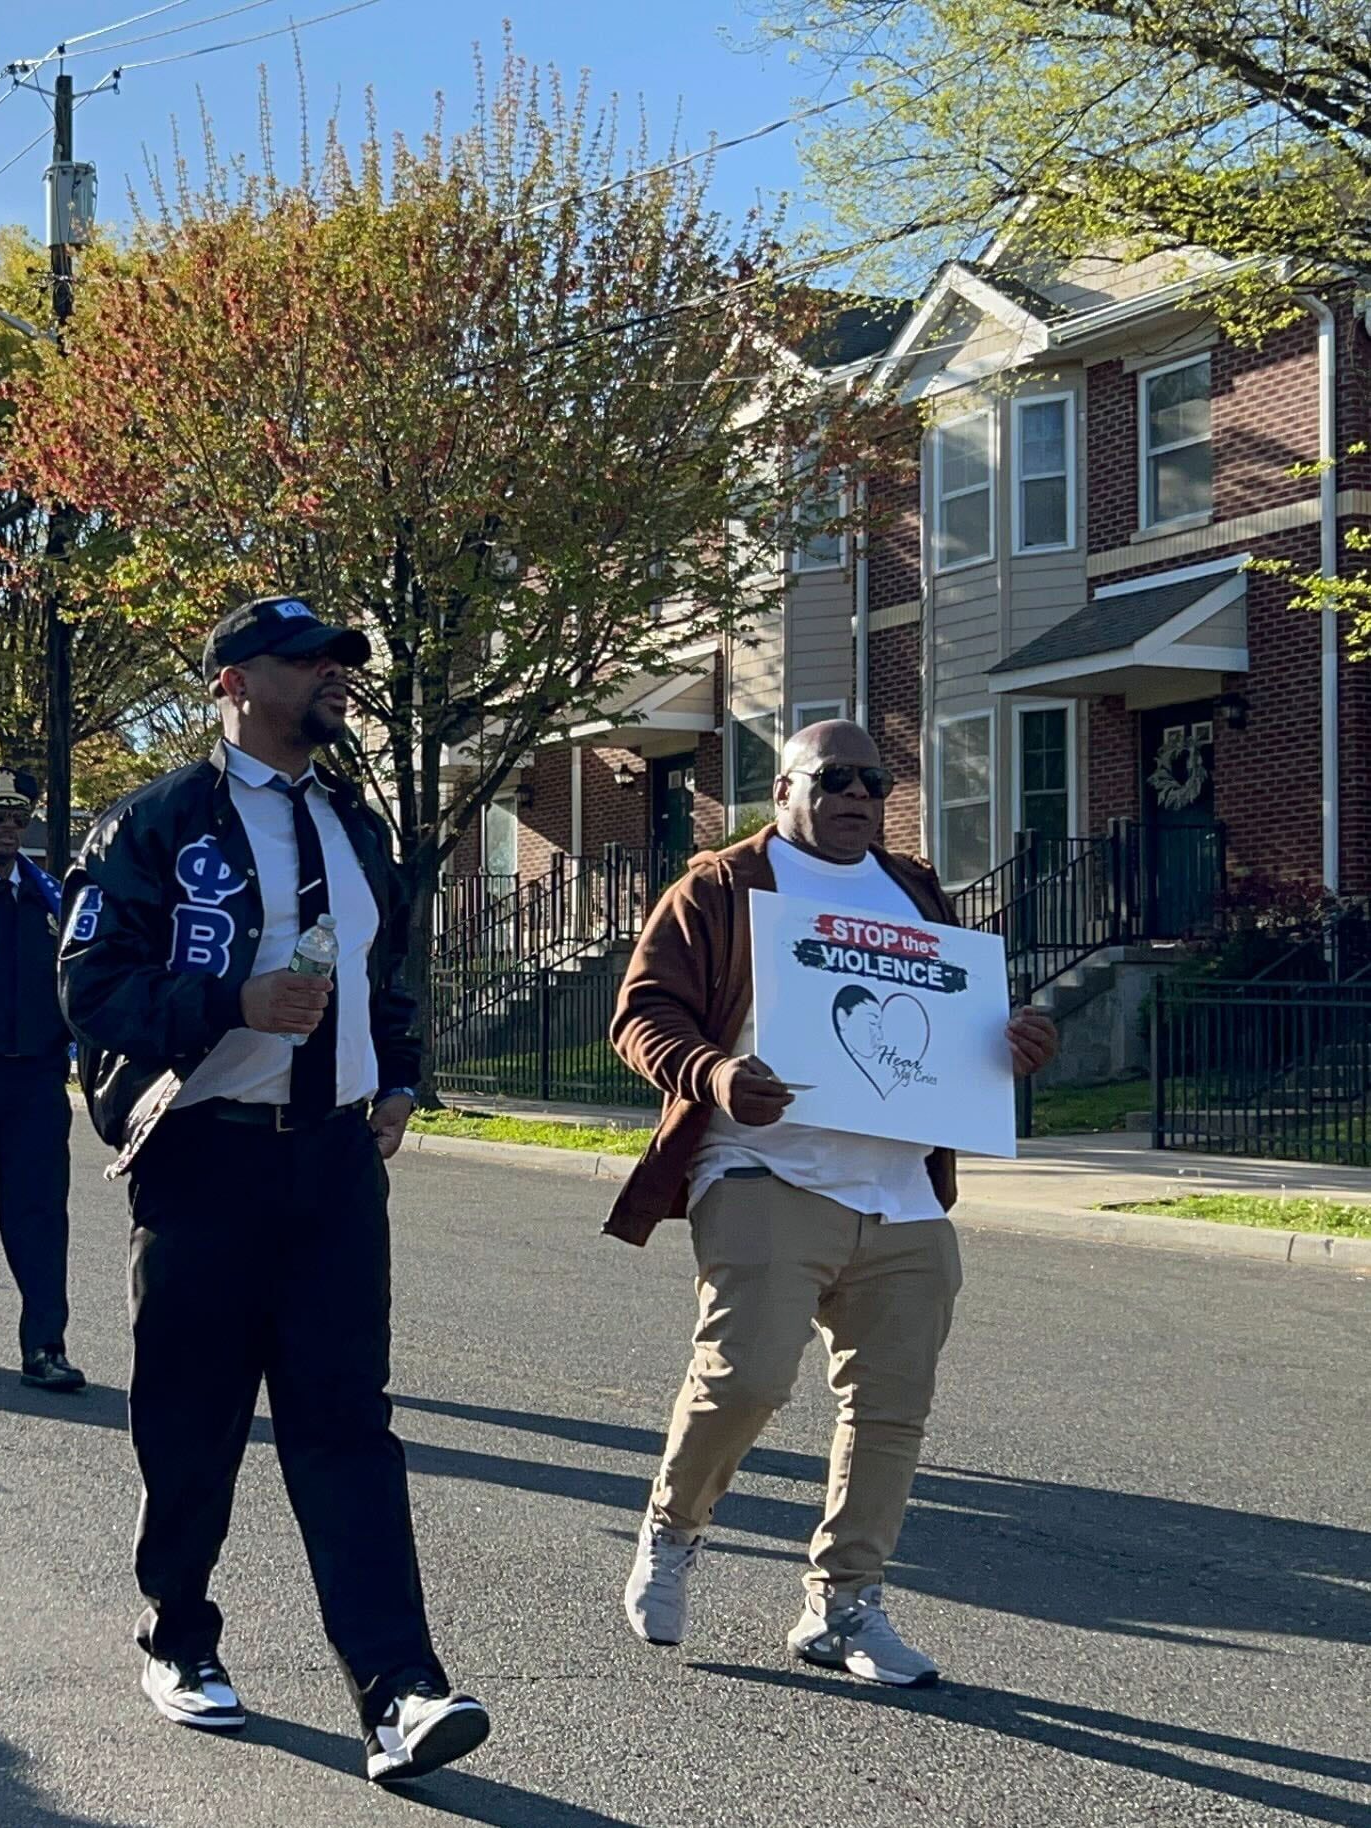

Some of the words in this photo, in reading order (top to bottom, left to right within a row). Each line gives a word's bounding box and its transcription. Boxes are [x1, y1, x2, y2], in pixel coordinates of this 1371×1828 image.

[831, 918, 899, 949] STOP
[902, 934, 929, 954] the
[820, 944, 946, 988] VIOLENCE
[877, 1044, 923, 1070] Hear
